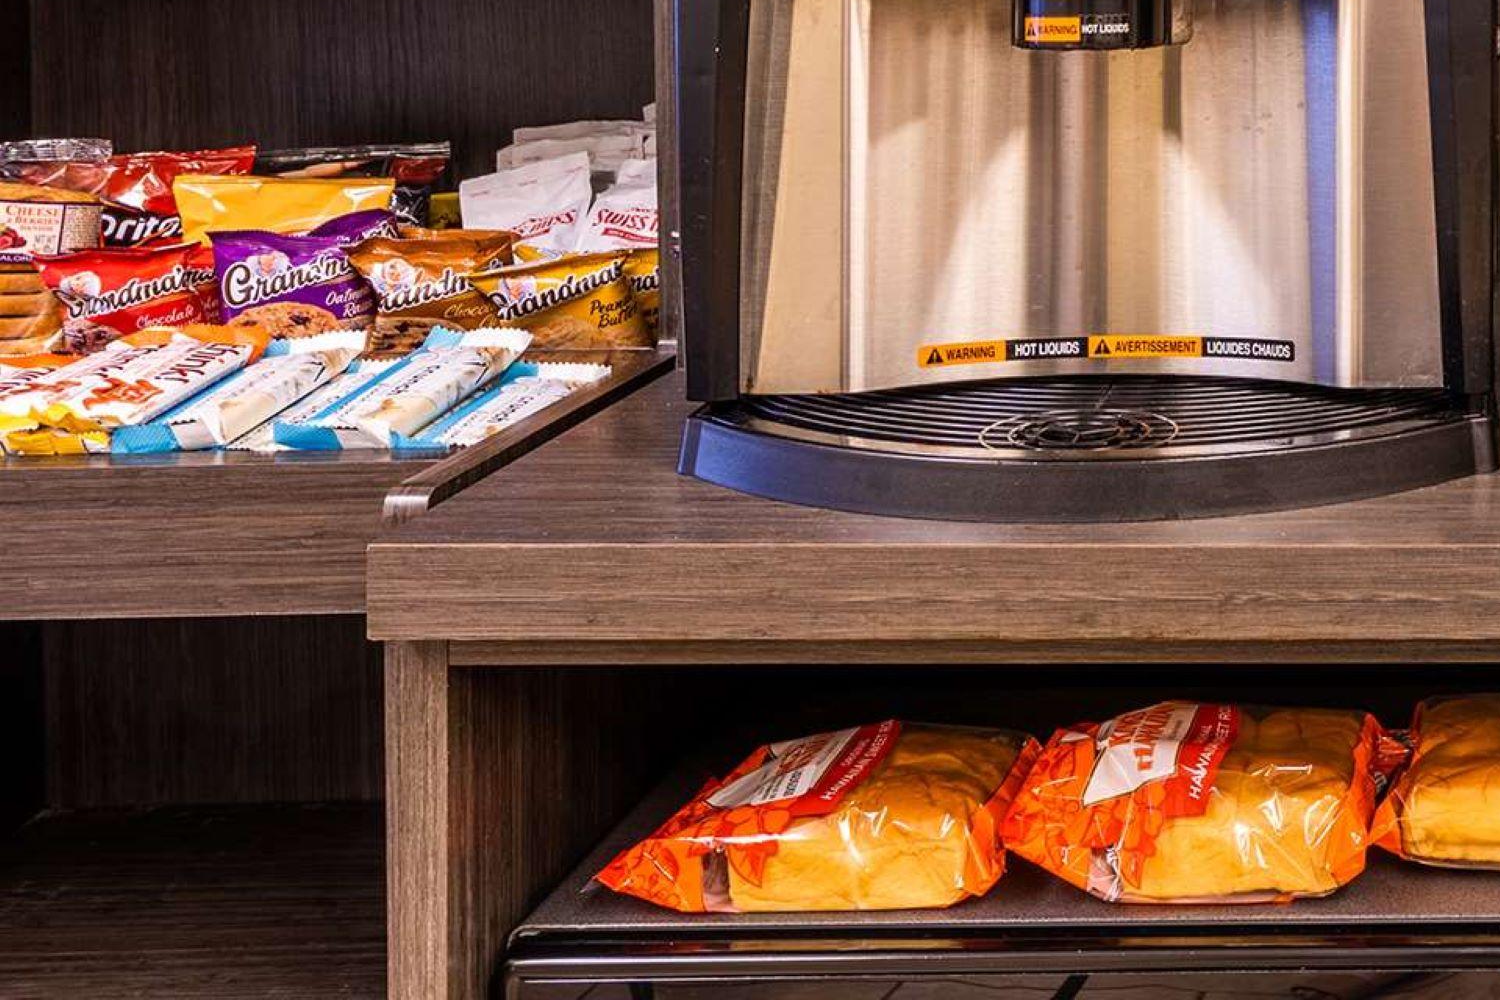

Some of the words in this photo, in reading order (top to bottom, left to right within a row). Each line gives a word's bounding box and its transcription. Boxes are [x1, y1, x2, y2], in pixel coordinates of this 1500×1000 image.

[945, 346, 996, 361] WARNING
[1014, 343, 1037, 357] HOT
[1038, 341, 1080, 356] LIQUIDS
[1114, 340, 1197, 353] AVERTISSEMENT
[1206, 341, 1251, 356] LIQUIDES
[1252, 343, 1291, 359] CHAUDS
